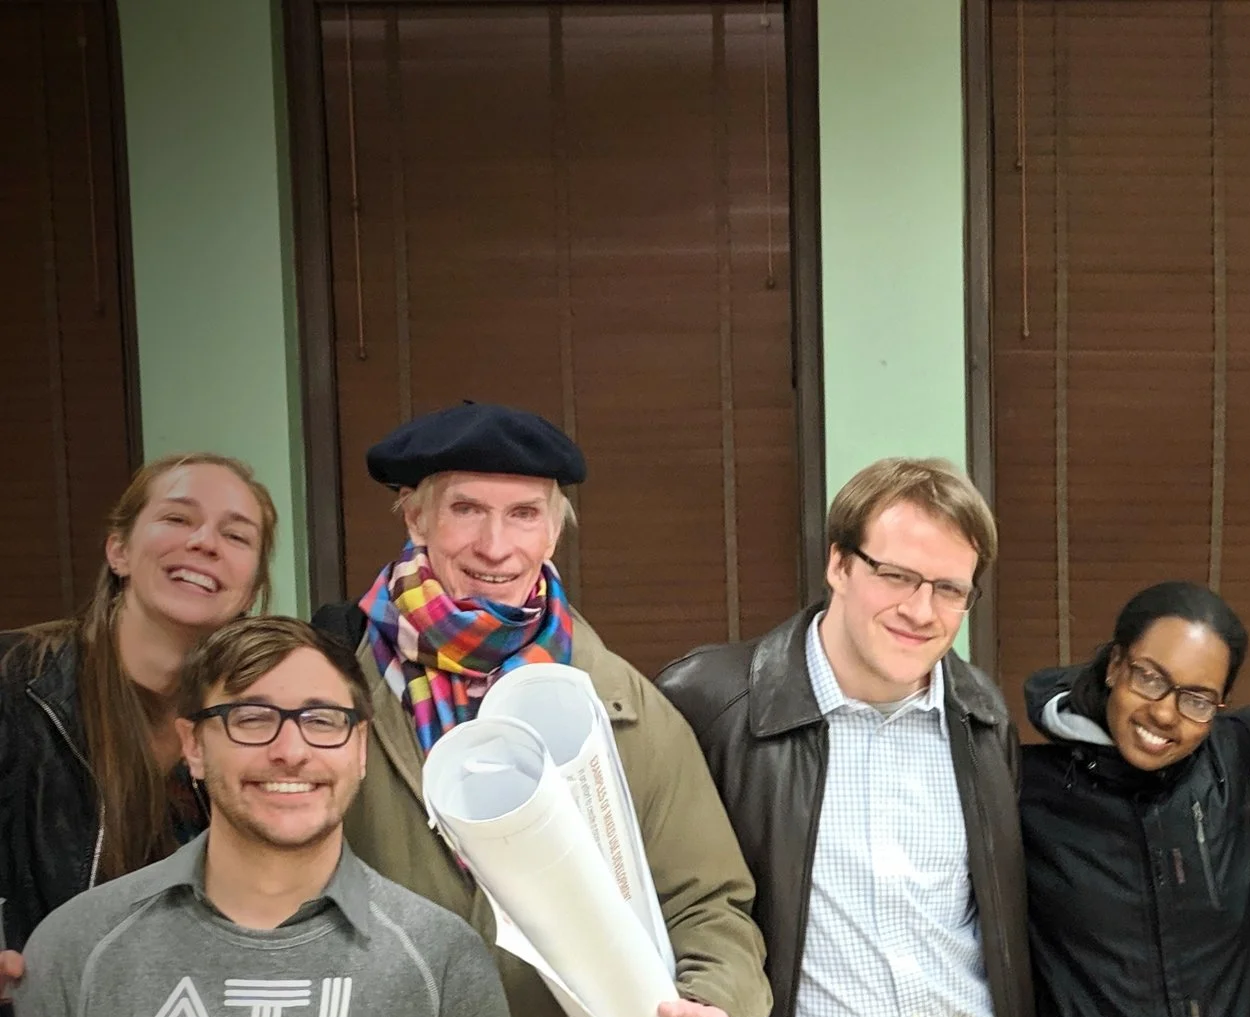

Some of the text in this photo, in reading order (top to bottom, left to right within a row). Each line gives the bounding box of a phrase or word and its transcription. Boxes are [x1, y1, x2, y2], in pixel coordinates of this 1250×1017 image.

[589, 754, 632, 902] EXAMPLES OF MIXED USE DEVELOPMENT
